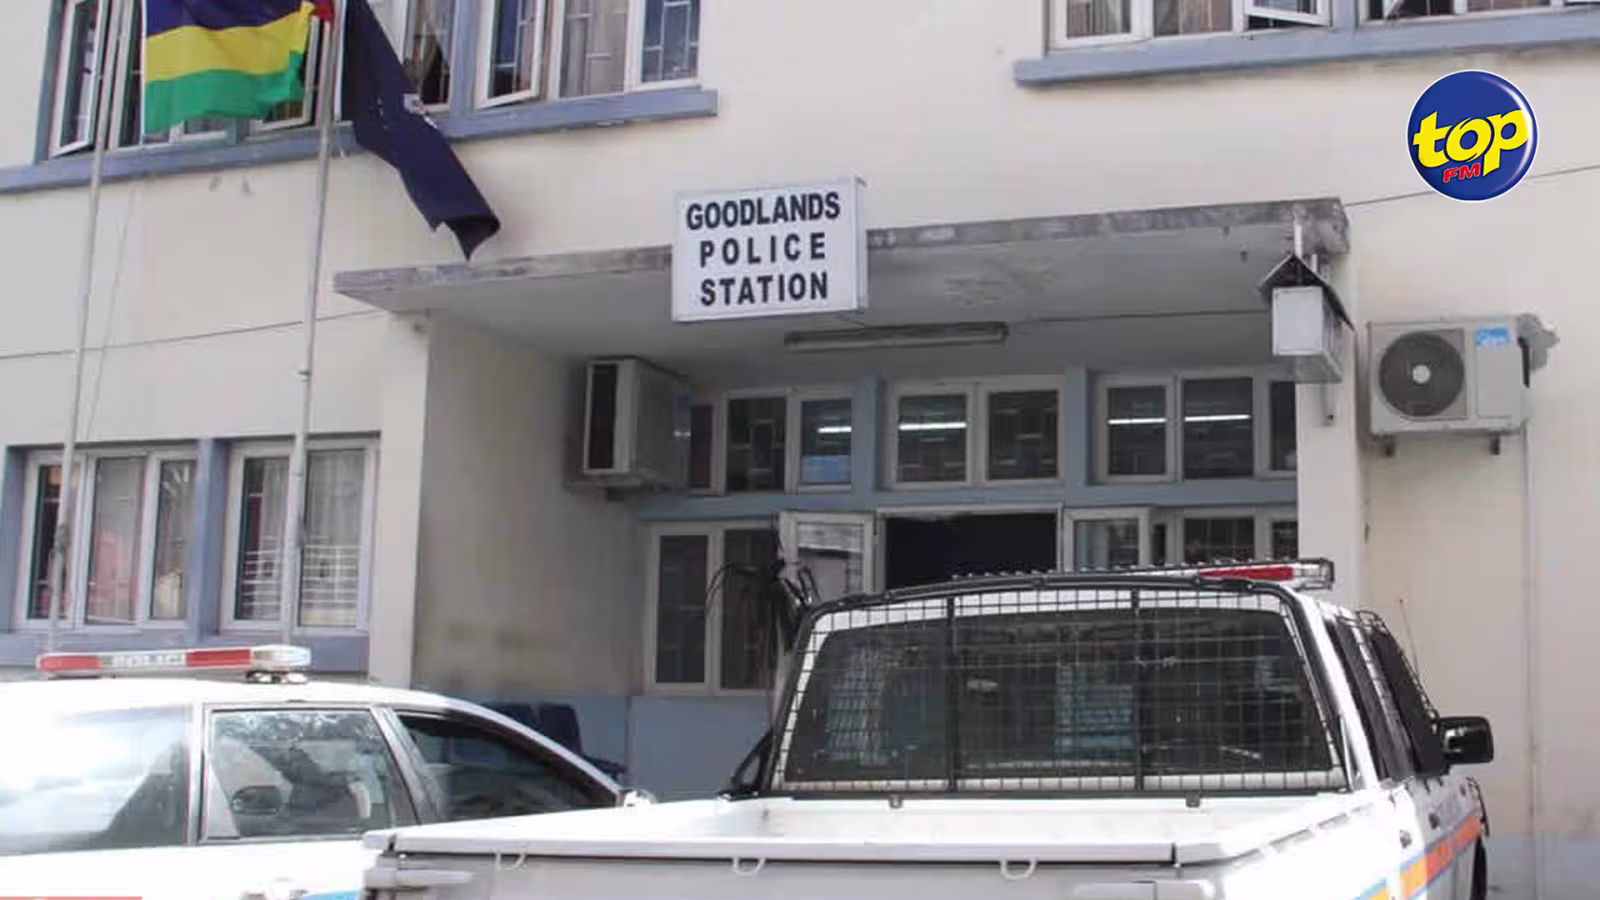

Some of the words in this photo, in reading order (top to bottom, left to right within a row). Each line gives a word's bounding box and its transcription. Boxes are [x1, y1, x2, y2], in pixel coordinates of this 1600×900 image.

[686, 191, 841, 230] GOODLANDS
[700, 232, 826, 268] POLICE
[701, 271, 828, 306] STATION
